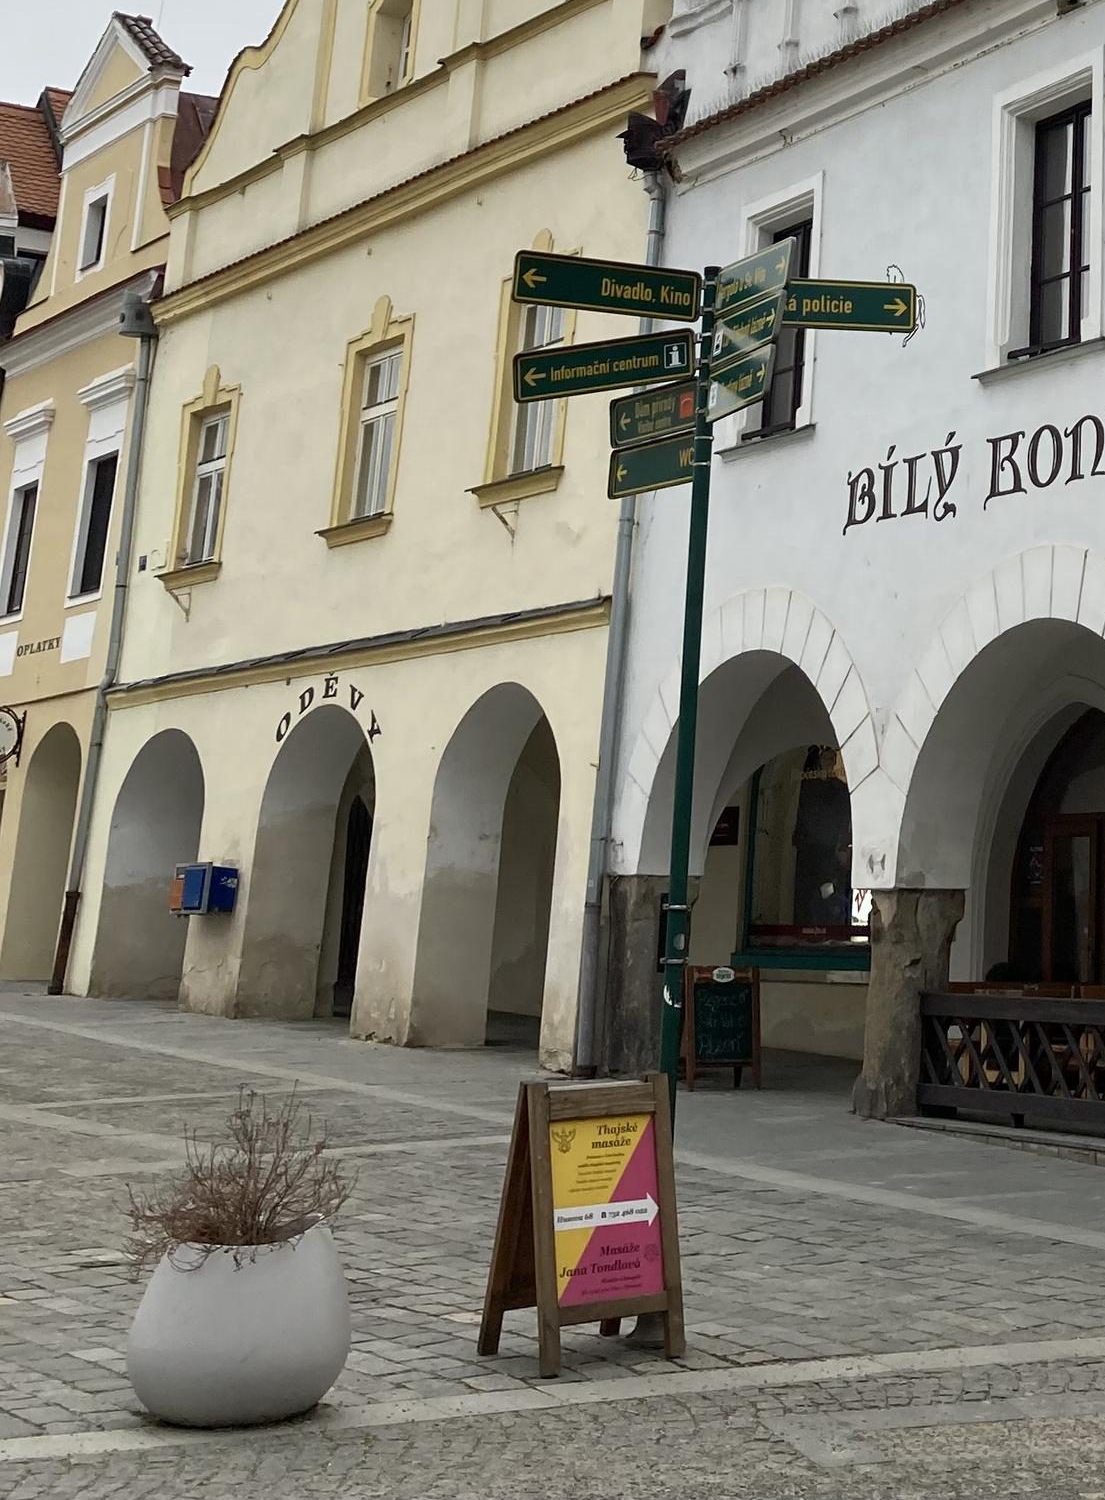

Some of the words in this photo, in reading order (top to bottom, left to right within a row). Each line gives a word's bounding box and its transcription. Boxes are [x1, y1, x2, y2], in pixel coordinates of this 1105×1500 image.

[601, 277, 657, 304] Divadlo,
[660, 284, 691, 306] Kino
[802, 294, 854, 317] policie
[550, 357, 610, 381] Informační
[612, 353, 660, 372] centrum
[679, 446, 695, 468] WC
[842, 431, 963, 536] BÍLÝ
[16, 636, 62, 657] OPLATKY
[276, 671, 382, 745] ODĚVY
[597, 1121, 639, 1137] Thajské
[591, 1136, 632, 1150] masáže
[600, 1241, 641, 1257] Masáže
[559, 1266, 588, 1279] Jana
